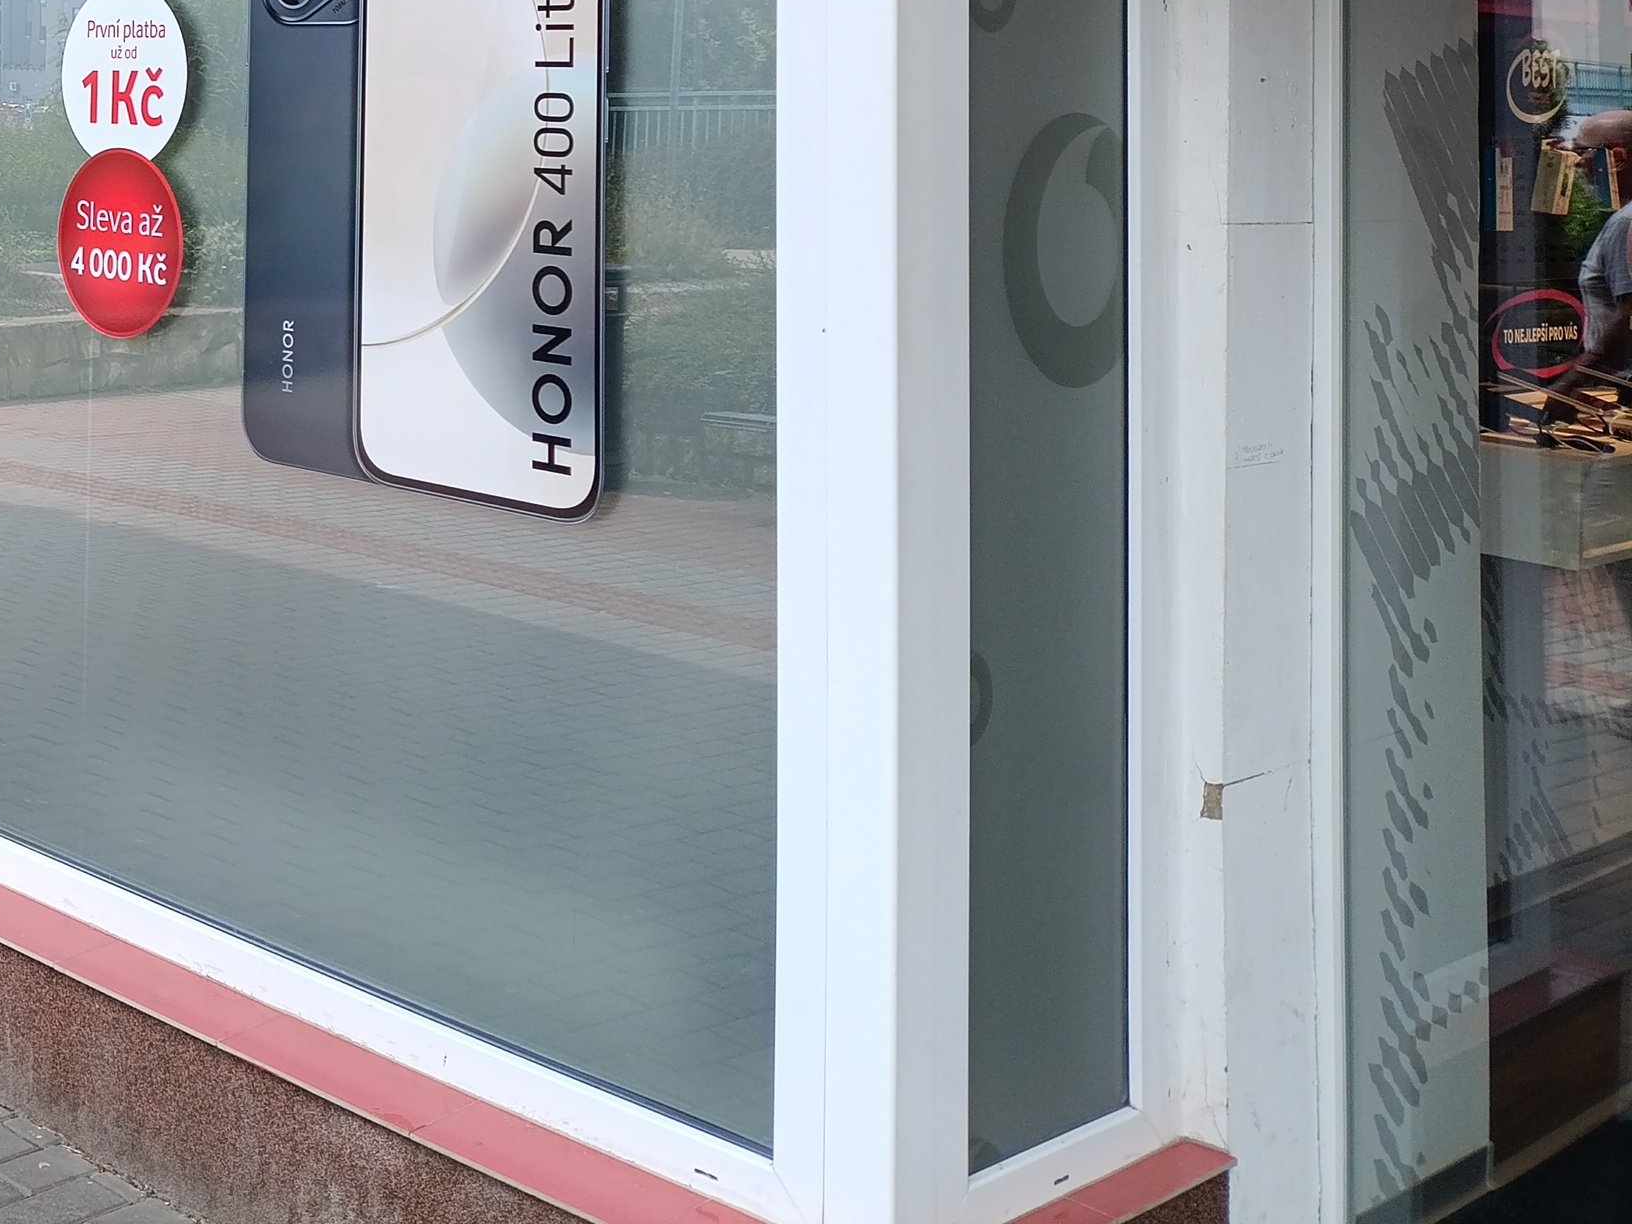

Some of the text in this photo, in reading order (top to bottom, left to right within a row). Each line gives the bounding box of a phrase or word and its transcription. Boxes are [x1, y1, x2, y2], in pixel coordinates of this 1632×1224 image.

[87, 18, 166, 44] První platba
[110, 46, 138, 60] už od
[1522, 48, 1561, 89] BEST
[82, 68, 164, 126] 1 Kč
[533, 92, 575, 196] 400
[76, 199, 164, 237] Sleva až
[71, 247, 167, 286] 4 000 Kč
[531, 219, 573, 476] HONOR
[1503, 322, 1578, 344] TO NEJLEPŠÍ PRO VÁS
[281, 320, 295, 393] HONOR
